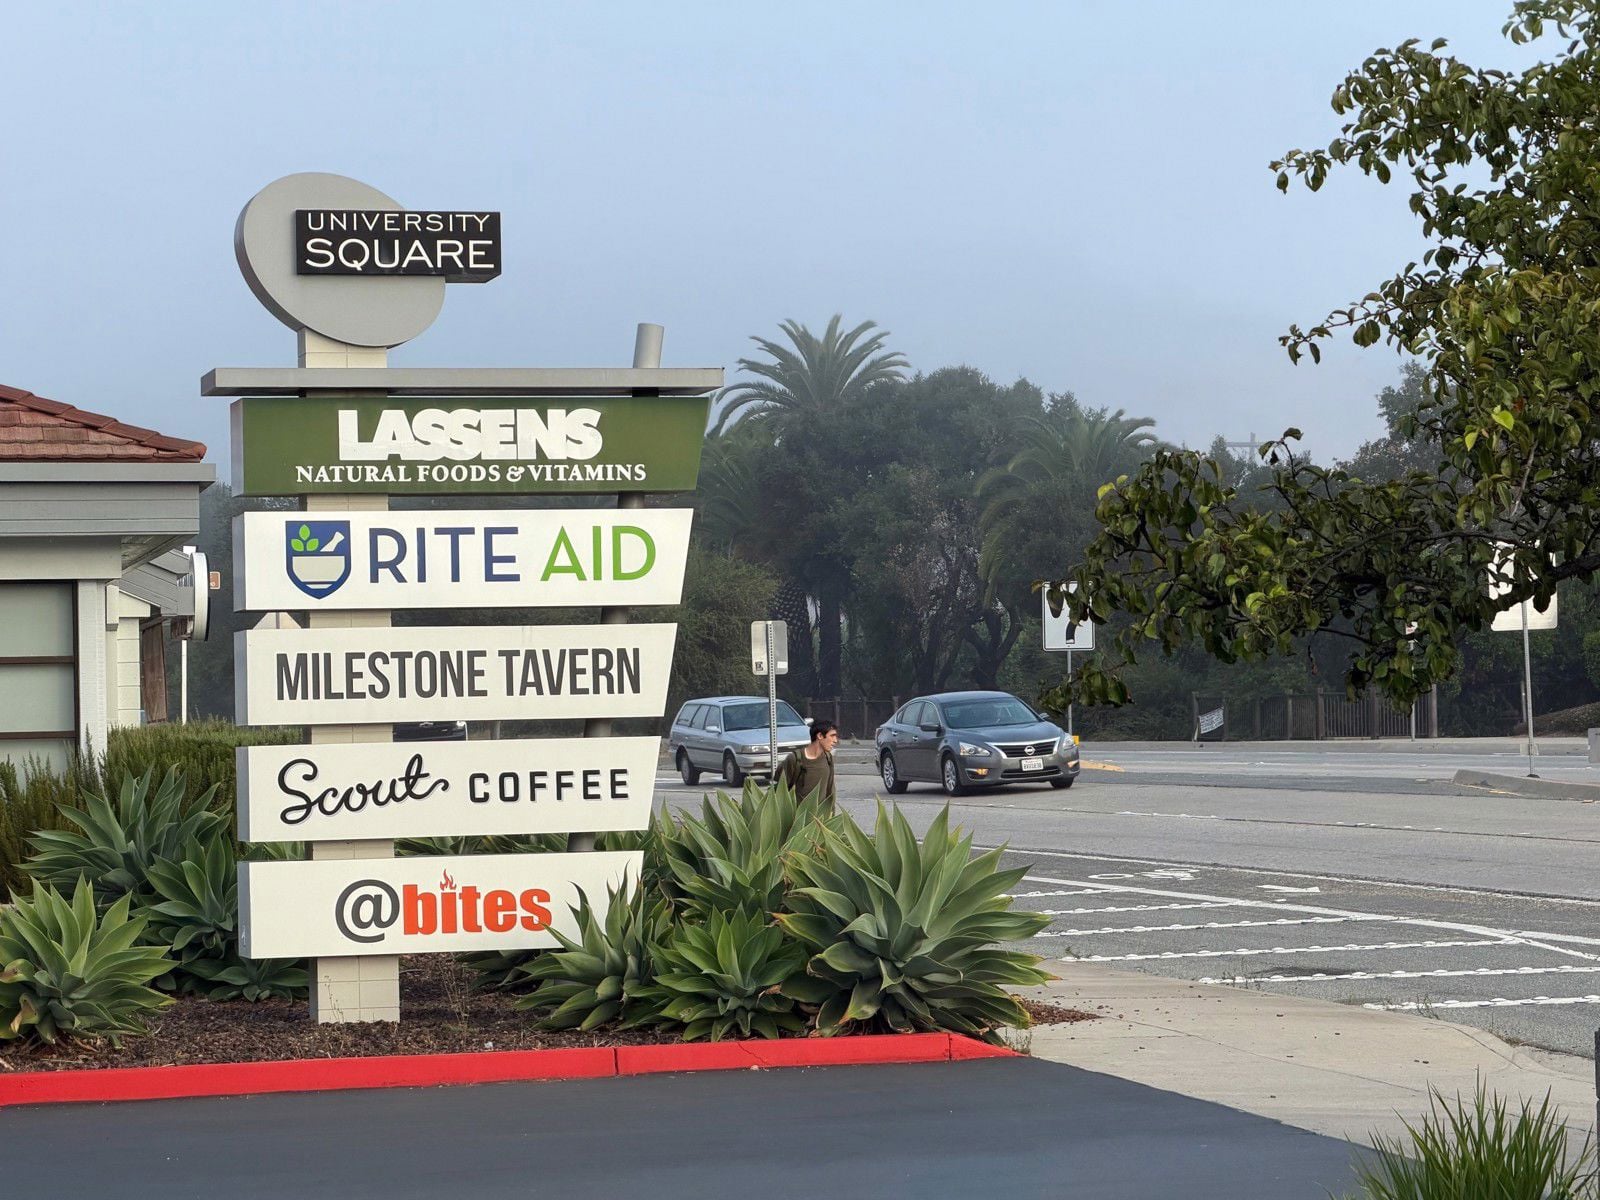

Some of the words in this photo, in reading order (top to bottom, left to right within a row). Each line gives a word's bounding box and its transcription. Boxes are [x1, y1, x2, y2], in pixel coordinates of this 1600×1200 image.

[307, 213, 490, 232] UNIVERSITY
[305, 238, 495, 270] SQUARE
[338, 408, 603, 461] LASSENS
[295, 465, 411, 483] NATURAL
[417, 465, 501, 482] FOODS
[506, 466, 525, 482] &
[527, 464, 647, 482] VITAMINS
[368, 527, 520, 584] RITE
[541, 525, 657, 581] AID
[276, 650, 488, 700] MILESTONE
[498, 648, 641, 697] TAVERN
[277, 753, 449, 825] Scout
[468, 768, 628, 803] COFFEE
[335, 870, 552, 943] @bites
